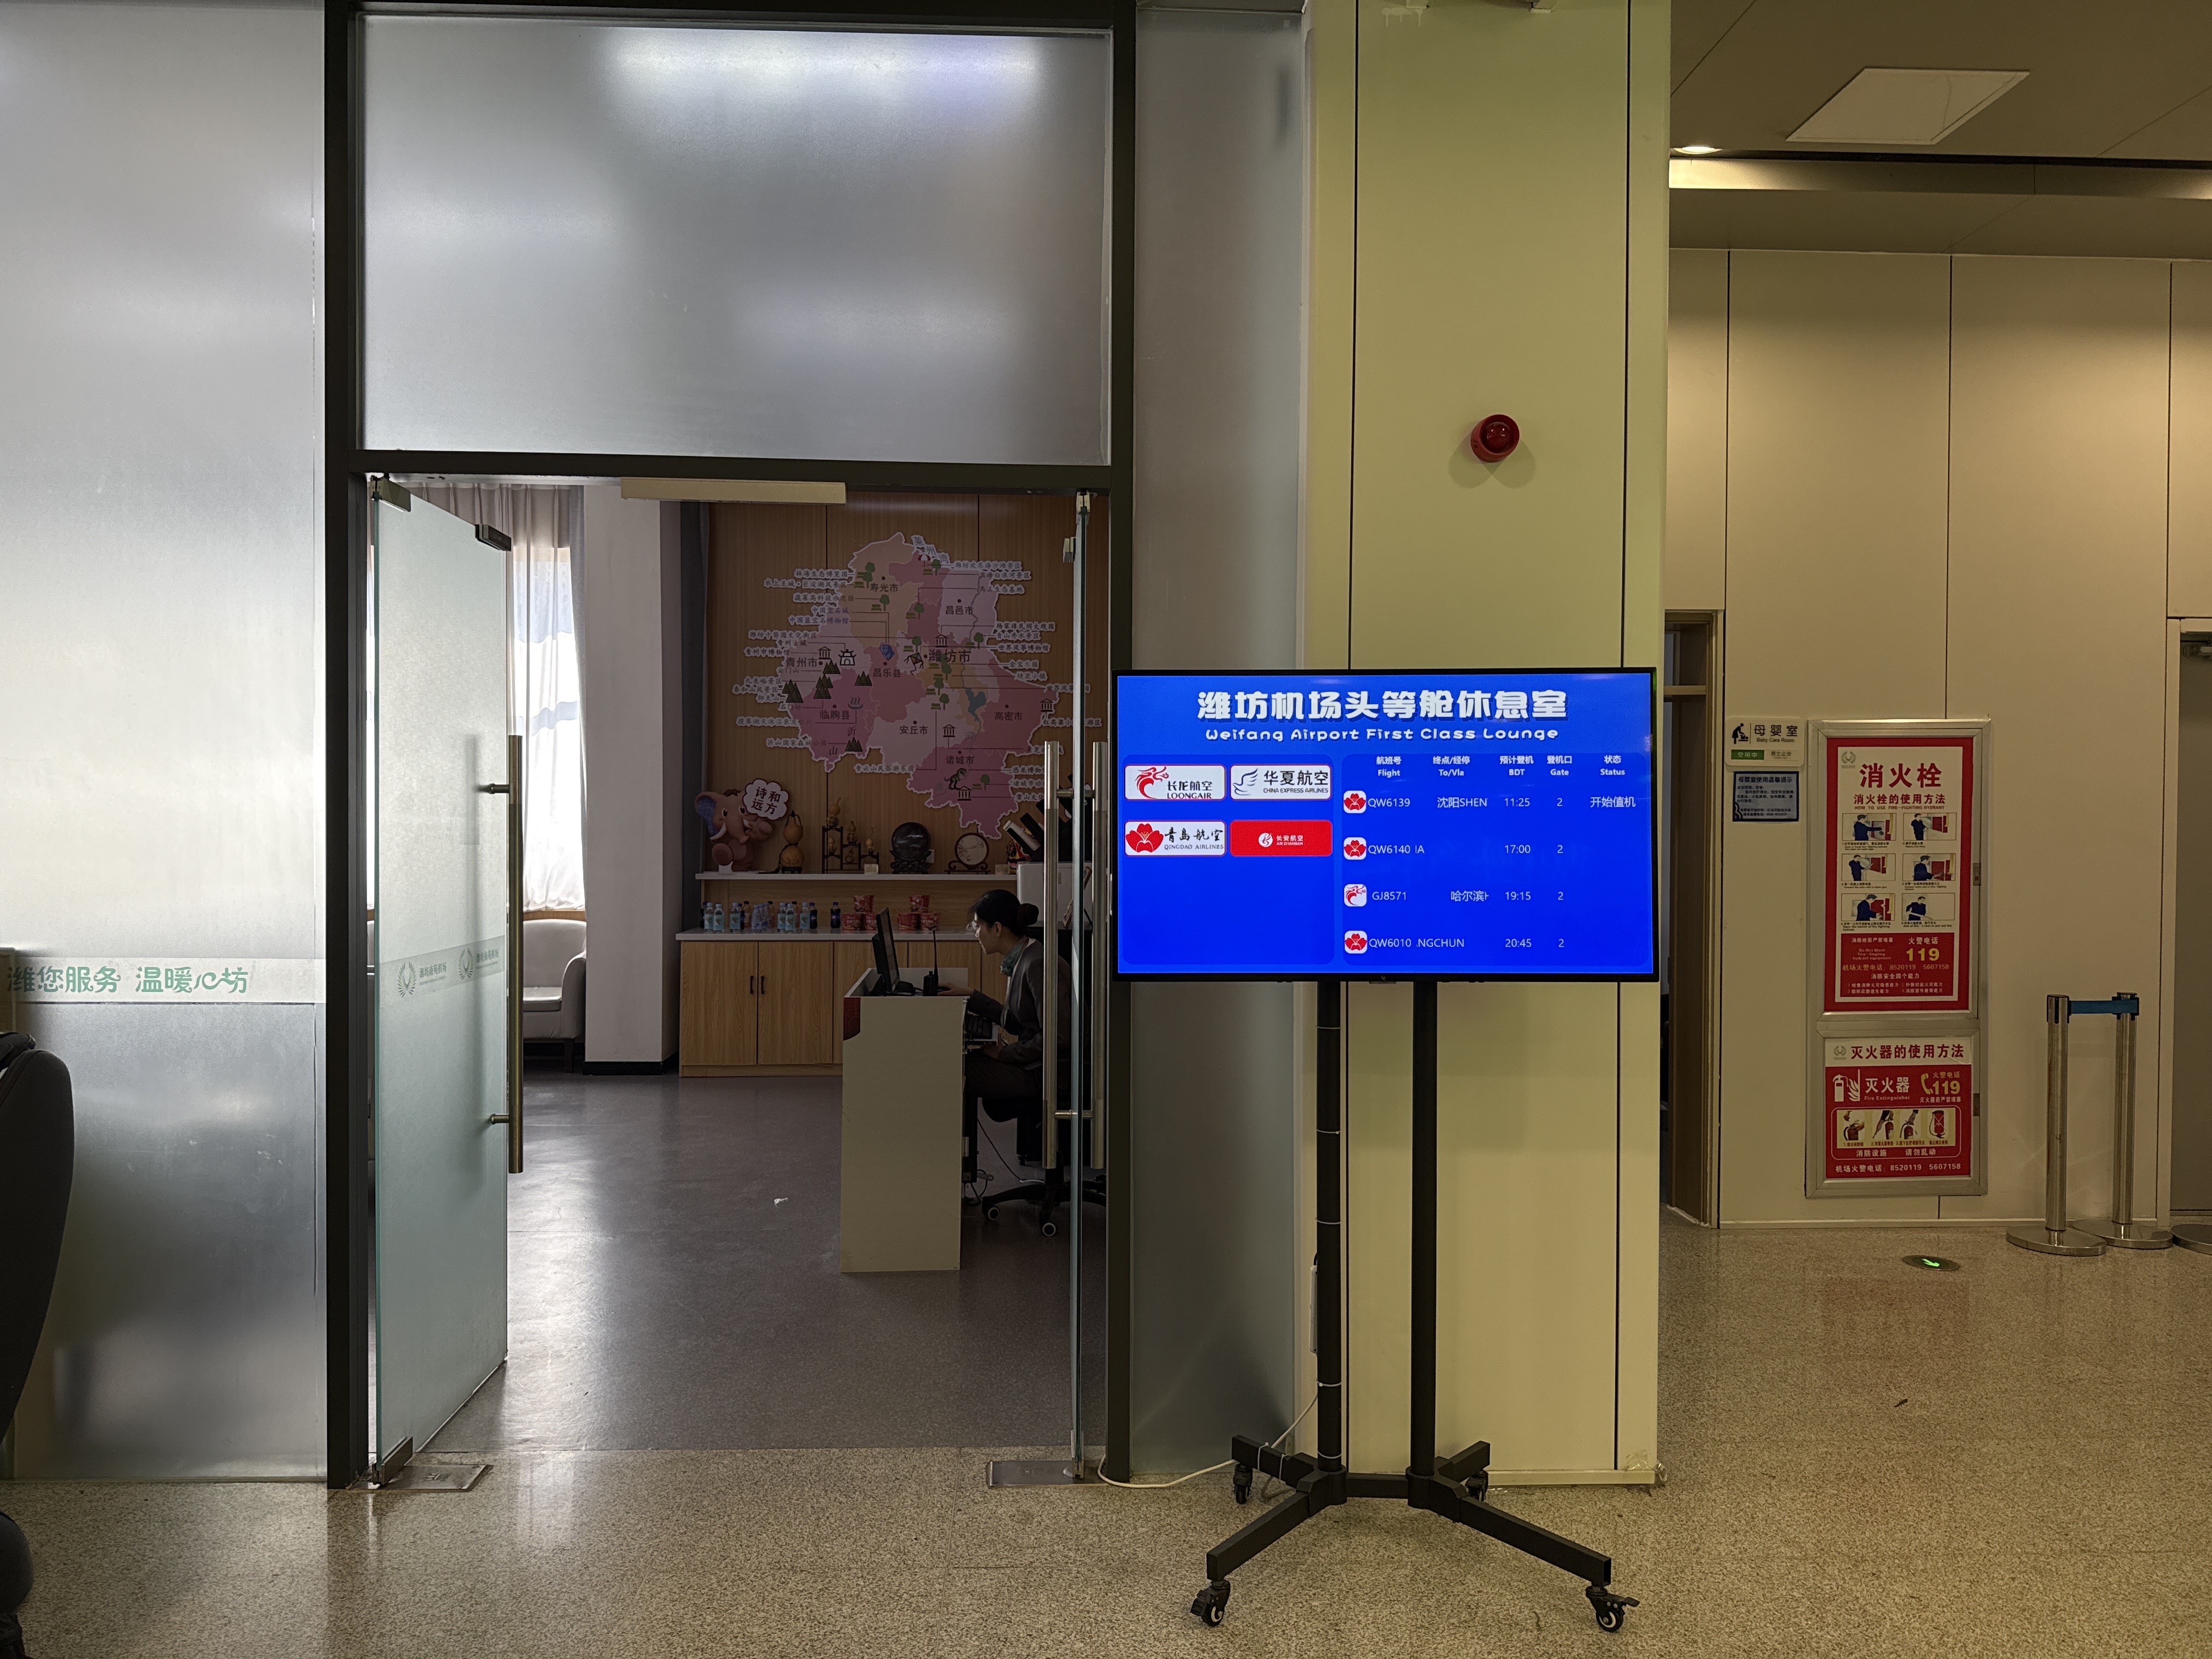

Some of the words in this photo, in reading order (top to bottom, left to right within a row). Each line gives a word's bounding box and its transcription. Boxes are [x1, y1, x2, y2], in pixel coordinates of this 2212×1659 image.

[870, 583, 898, 592] 寿光市
[945, 605, 974, 615] 昌邑市
[928, 650, 972, 663] 潍坊市
[785, 658, 817, 668] 青州市
[873, 668, 901, 678] 昌乐县
[1198, 690, 1567, 719] 潍坊机场头等舱休息室
[994, 711, 1023, 721] 高密市
[899, 725, 928, 735] 安丘市
[1205, 729, 1284, 742] Weifang
[1290, 729, 1359, 742] Airport
[1366, 728, 1414, 740] First
[1420, 728, 1476, 740] Class
[1483, 728, 1559, 741] Lounge
[1754, 725, 1798, 736] 母婴室
[829, 746, 838, 755] 山
[945, 755, 975, 765] 诸城市
[1376, 755, 1402, 765] 航班号
[1432, 755, 1471, 765] 终点/经停
[1499, 755, 1534, 765] 预计登机
[1547, 755, 1572, 764] 登机口
[1604, 755, 1622, 764] 状态
[1263, 770, 1328, 786] 华夏航空
[1378, 769, 1401, 778] Flight
[1859, 763, 1942, 788] 消火栓
[1167, 781, 1212, 791] 长龙航空
[756, 786, 781, 803] 诗和
[1854, 793, 1945, 804] 消火栓的使用方法
[751, 798, 777, 815] 远方
[1368, 798, 1410, 808] QW6139
[1437, 796, 1488, 809] 沈阳SHEN
[1504, 798, 1530, 807] 11:25
[1556, 798, 1563, 807] 2
[1590, 796, 1637, 808] 开始值机
[1164, 827, 1224, 843] 青岛航空
[1368, 844, 1410, 854] QW6140
[1504, 844, 1531, 854] 17:00
[1557, 844, 1564, 854] 2
[1372, 891, 1407, 901] GJ8571
[1505, 891, 1531, 900] 19:15
[1558, 891, 1564, 900] 2
[1369, 938, 1412, 948] QW6010
[1417, 938, 1464, 947] NGCHUN
[1505, 938, 1532, 947] 20:45
[1558, 938, 1564, 947] 2
[1908, 936, 1939, 945] 火警电话
[1906, 947, 1940, 961] 119
[7, 966, 121, 993] 潍您服务
[1851, 1043, 1964, 1060] 灭火器的使用方法
[1865, 1076, 1910, 1093] 灭火器
[1932, 1080, 1961, 1094] 119
